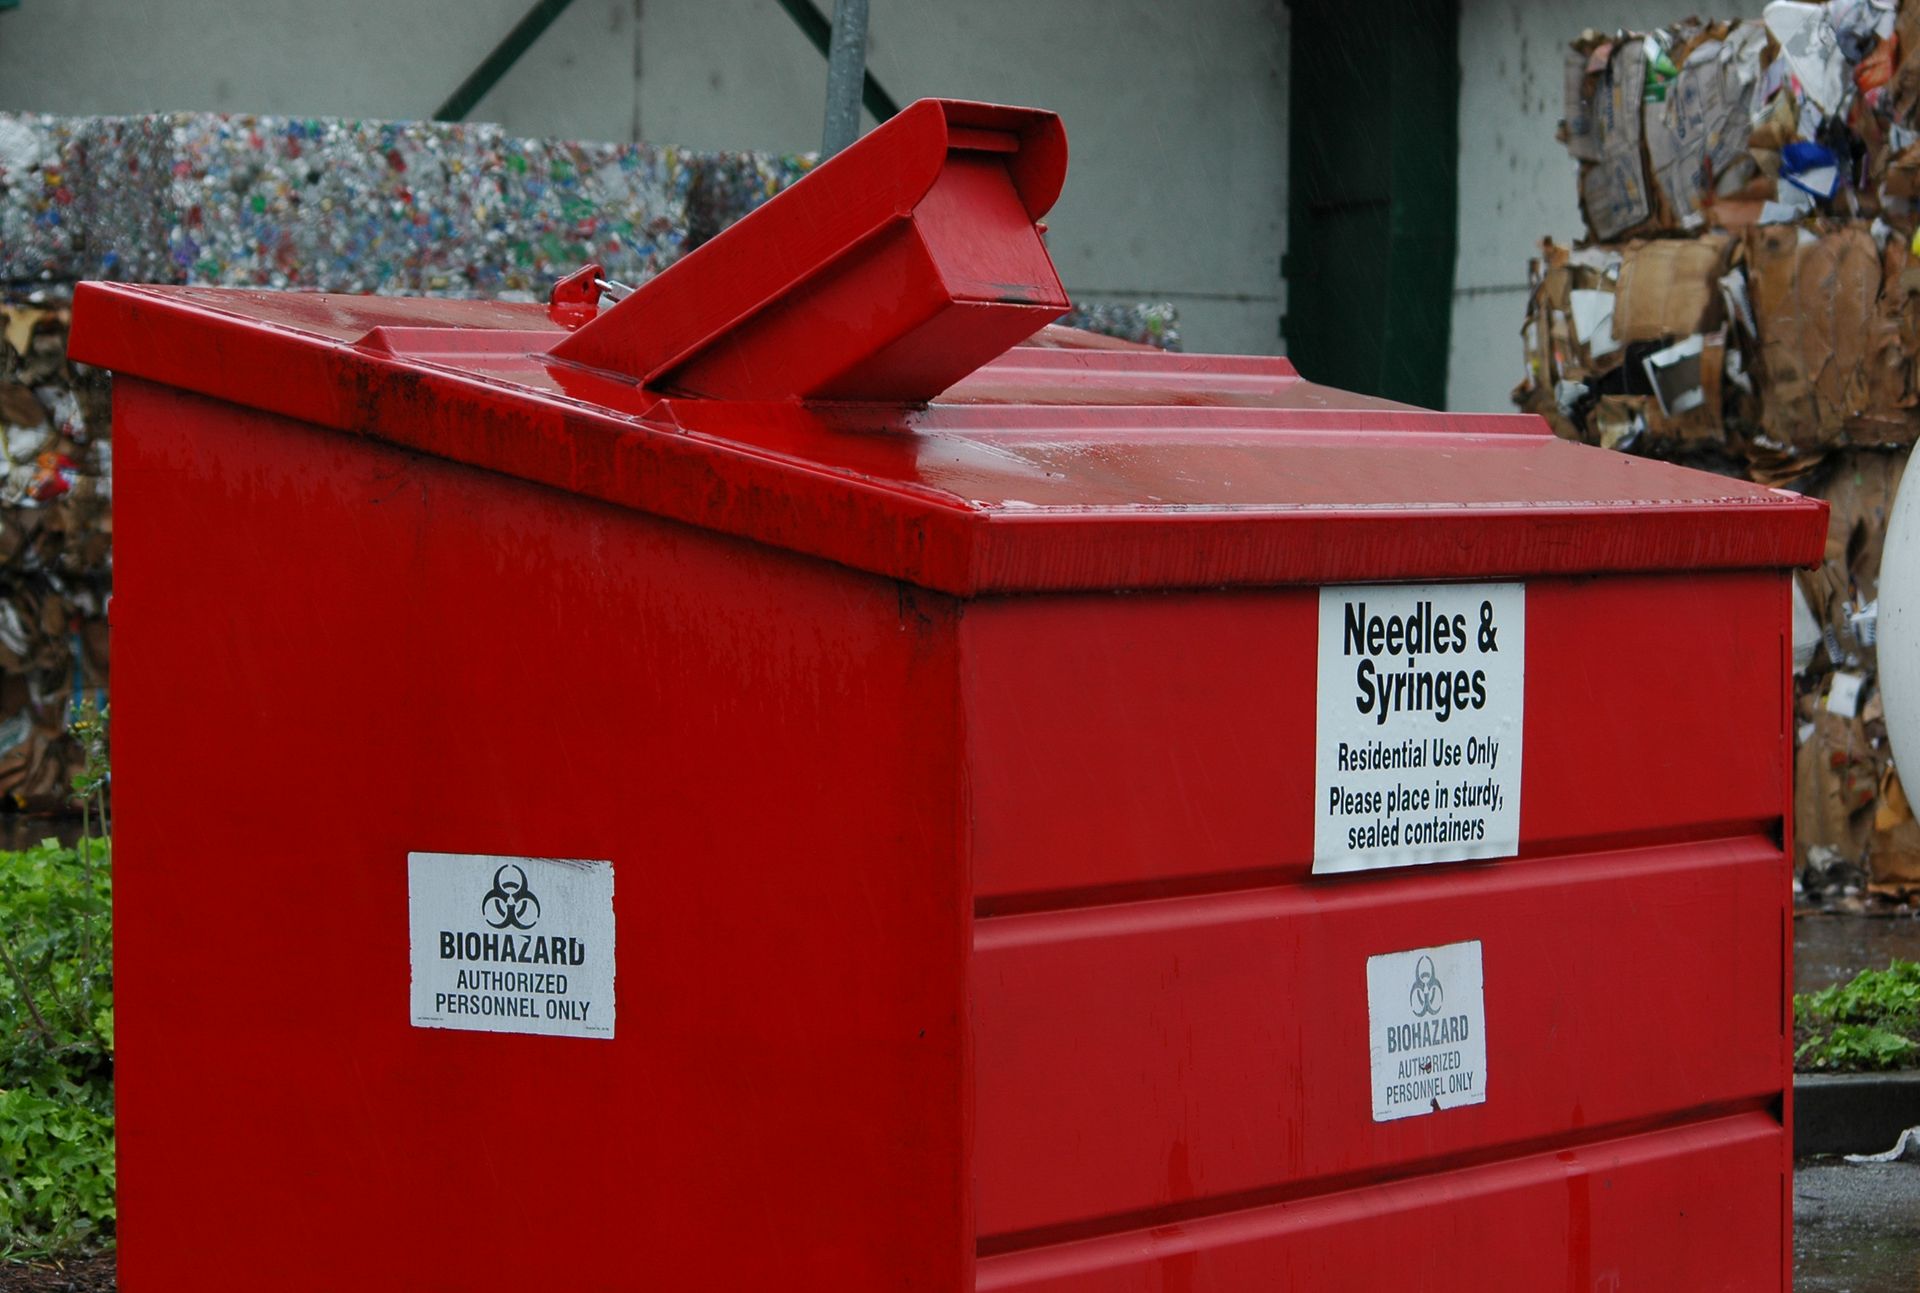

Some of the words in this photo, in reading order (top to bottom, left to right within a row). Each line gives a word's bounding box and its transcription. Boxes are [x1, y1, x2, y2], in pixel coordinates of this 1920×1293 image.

[1344, 601, 1467, 656] Needles
[1477, 600, 1498, 654] &
[1355, 657, 1487, 725] Syringes
[1338, 739, 1427, 771] Residential
[1432, 738, 1461, 767] Use
[1466, 736, 1499, 770] Only
[1329, 786, 1382, 815] Please
[1387, 783, 1430, 818] place
[1435, 780, 1448, 809] in
[1453, 778, 1503, 811] sturdy,
[1348, 817, 1399, 850] sealed
[1404, 813, 1485, 845] containers
[440, 931, 585, 966] BIOHAZARD
[457, 969, 568, 994] AUTHORIZED
[436, 993, 540, 1018] PERSONNEL
[546, 999, 591, 1021] ONLY
[1387, 1015, 1469, 1054] BIOHAZARD
[1386, 1077, 1446, 1106] PERSONNEL
[1449, 1071, 1473, 1093] ONLY
